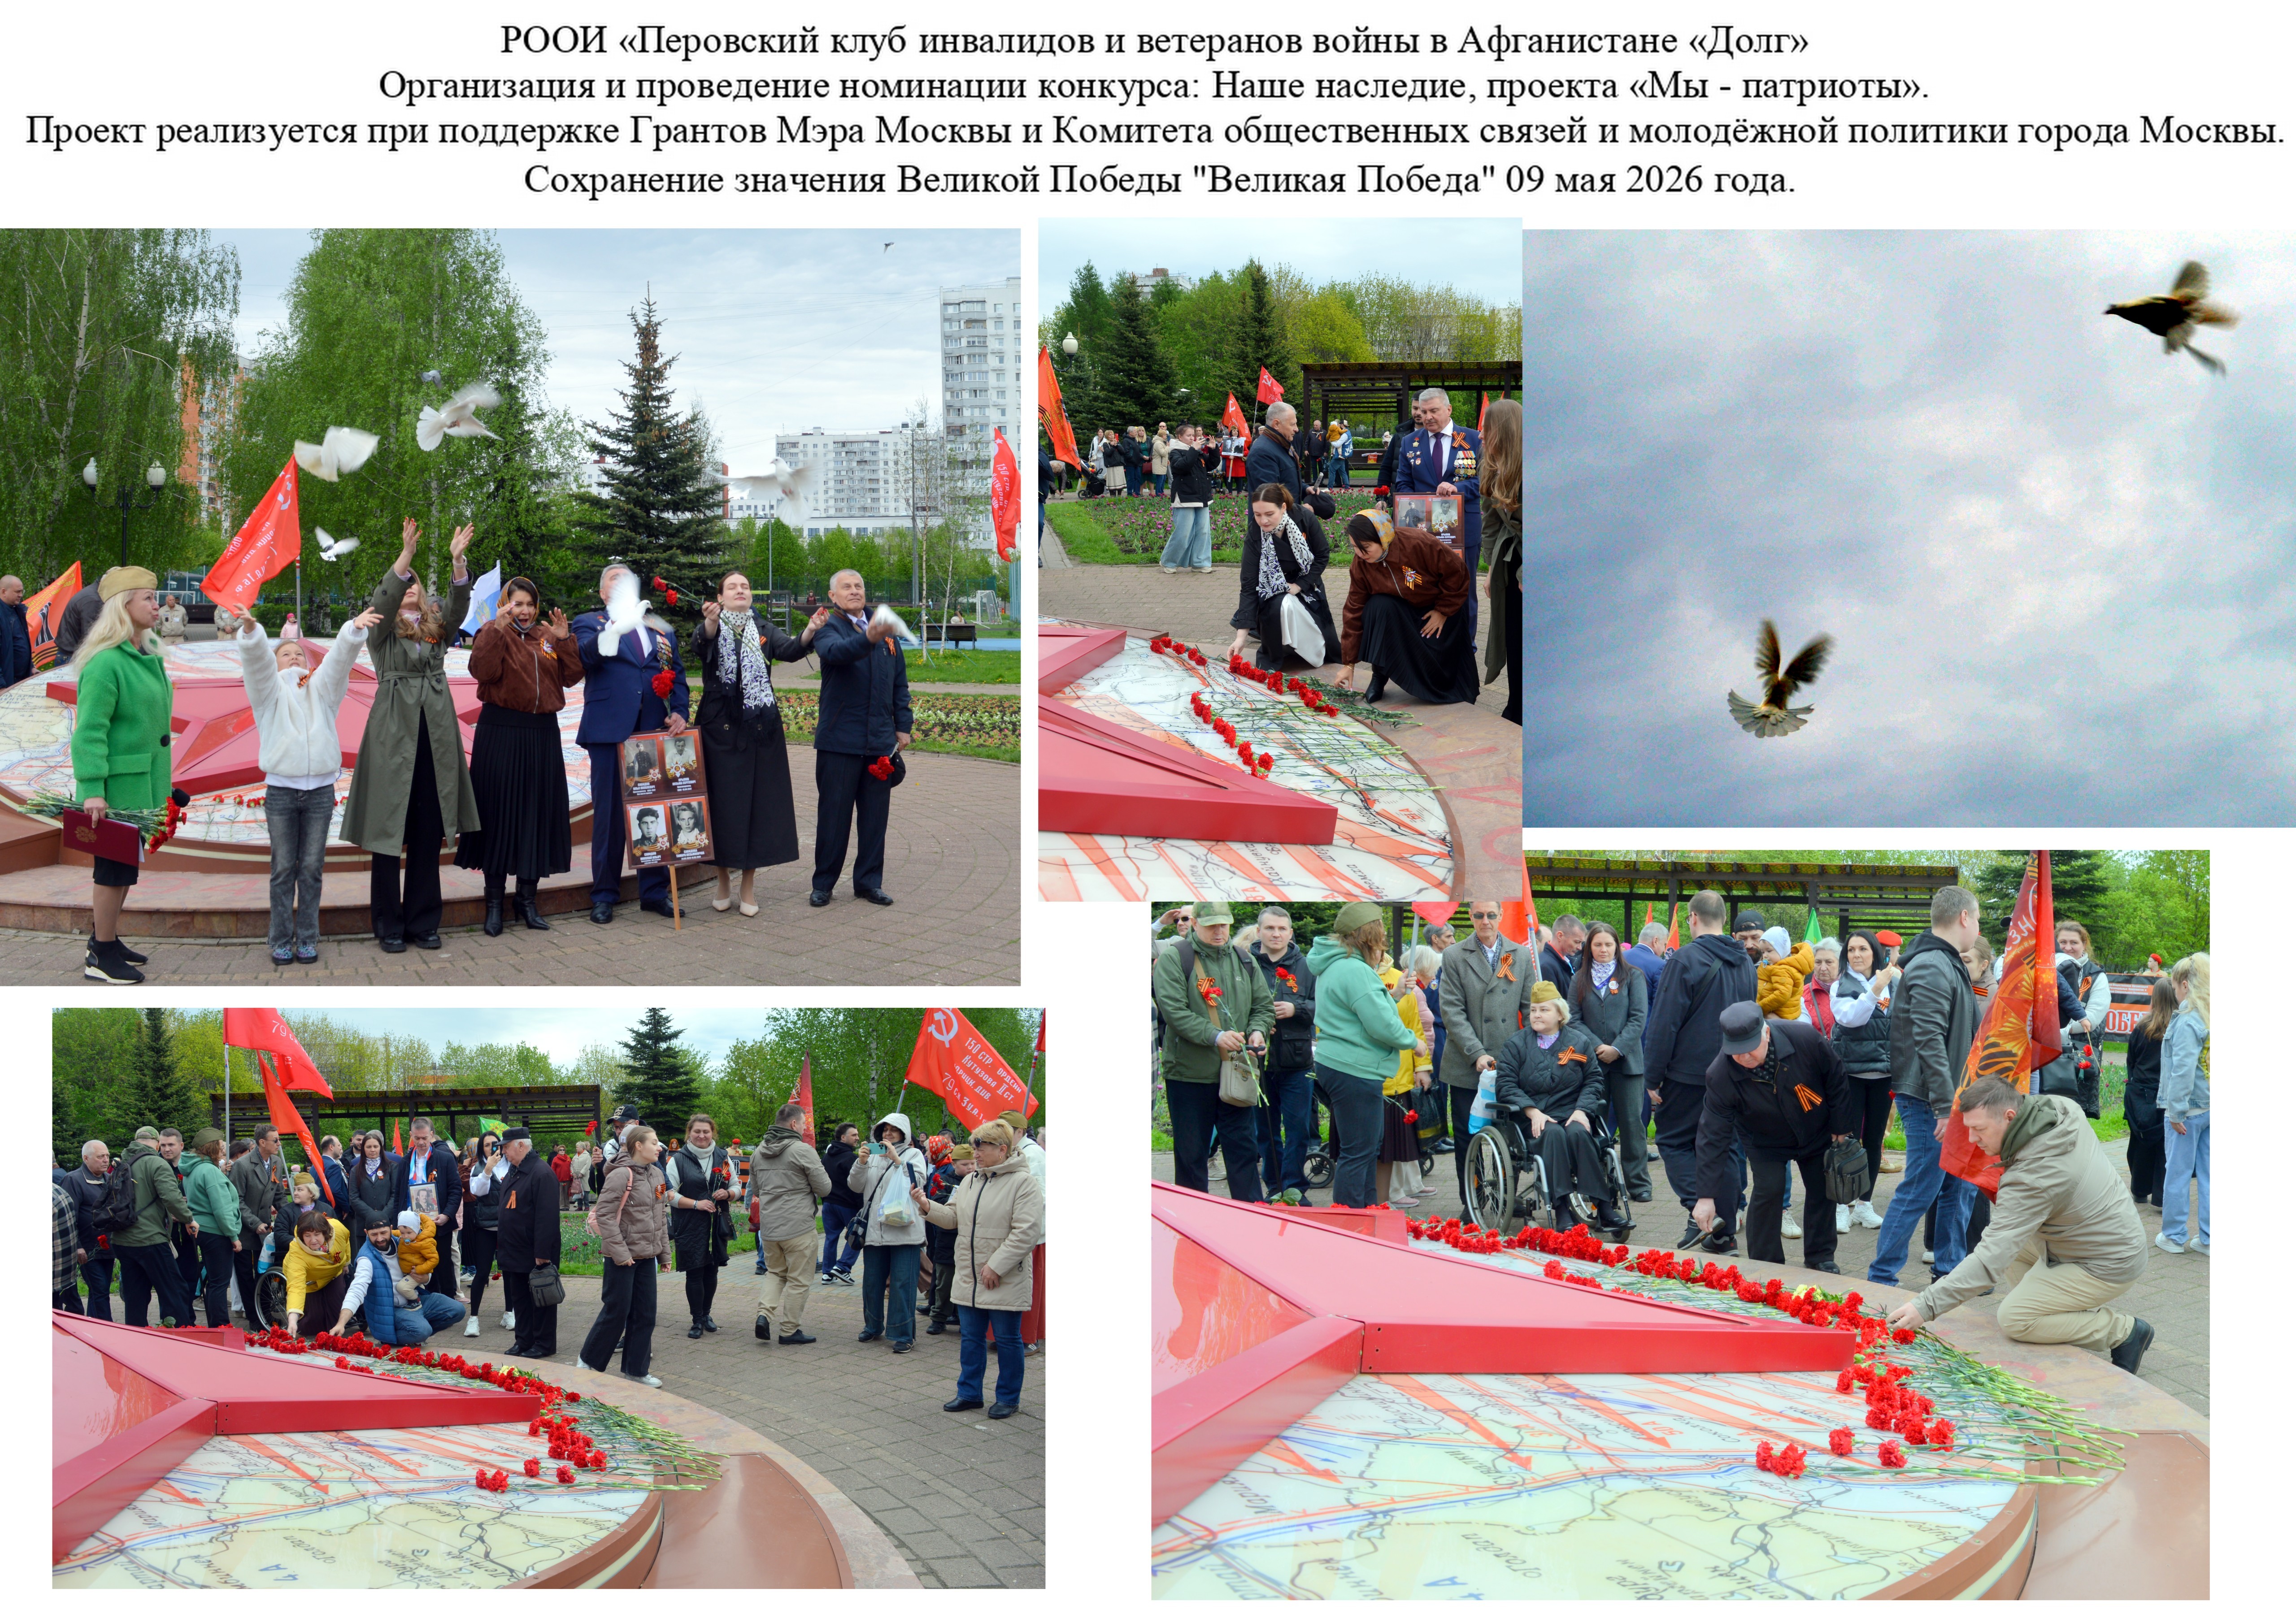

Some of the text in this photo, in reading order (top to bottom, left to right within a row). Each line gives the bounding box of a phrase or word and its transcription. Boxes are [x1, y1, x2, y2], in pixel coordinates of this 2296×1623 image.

[965, 1037, 982, 1054] 150
[978, 1051, 993, 1068] СТР.
[942, 1072, 955, 1091] 79
[954, 1063, 976, 1089] ДРИЦК.
